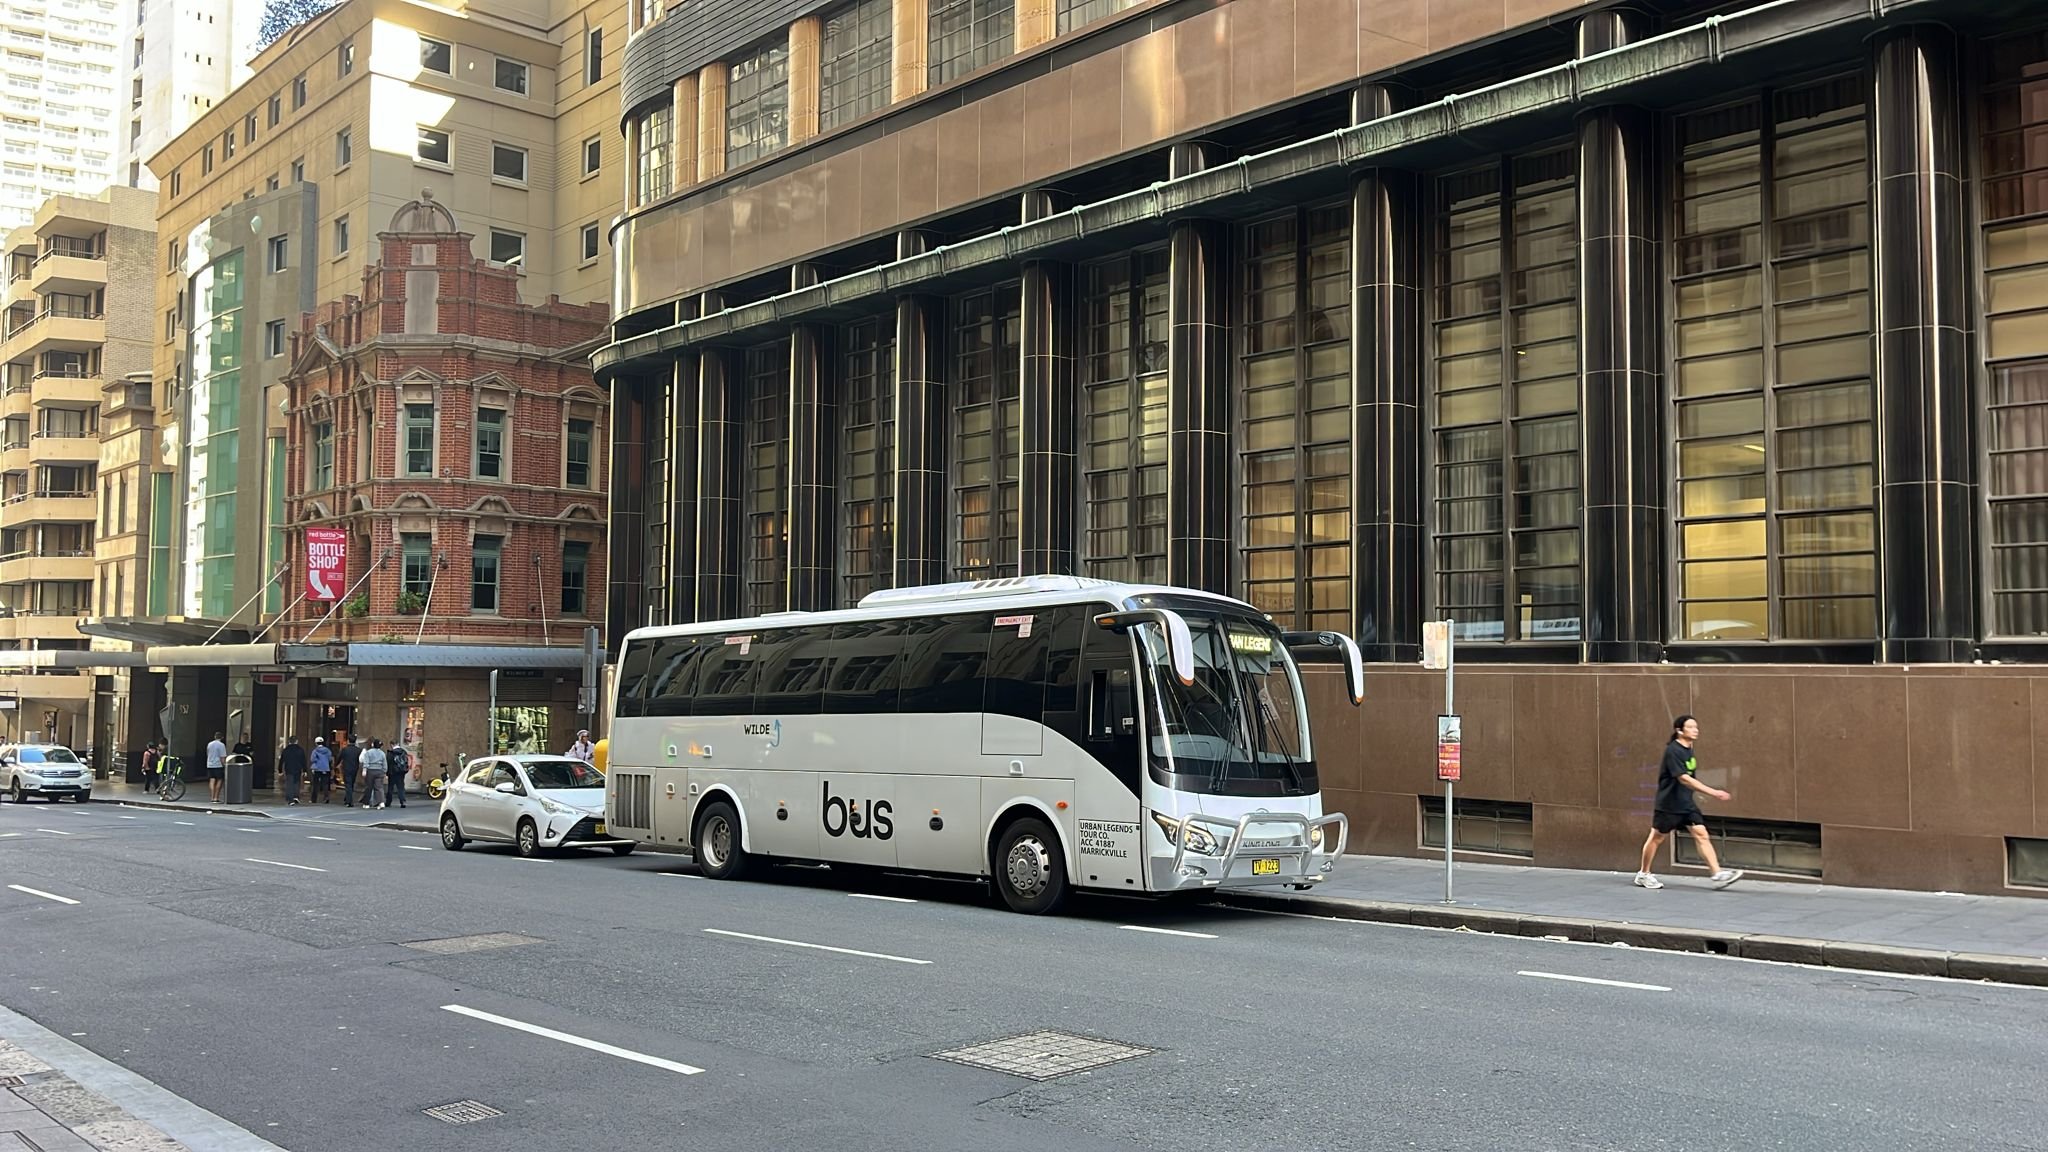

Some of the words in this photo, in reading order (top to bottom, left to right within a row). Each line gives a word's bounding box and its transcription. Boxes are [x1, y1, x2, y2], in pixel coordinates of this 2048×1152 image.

[309, 543, 345, 557] BOTTLE
[309, 556, 339, 569] SHOP
[744, 724, 770, 735] WILDE
[822, 781, 894, 840] bus
[1080, 822, 1102, 831] URBAN
[1103, 824, 1133, 833] LEGENDS
[1080, 830, 1097, 838] TOUR
[1098, 831, 1109, 840] CO.
[1080, 838, 1093, 847] ACC
[1095, 840, 1115, 848] 41887
[1080, 847, 1127, 857] MARRICKVILLE
